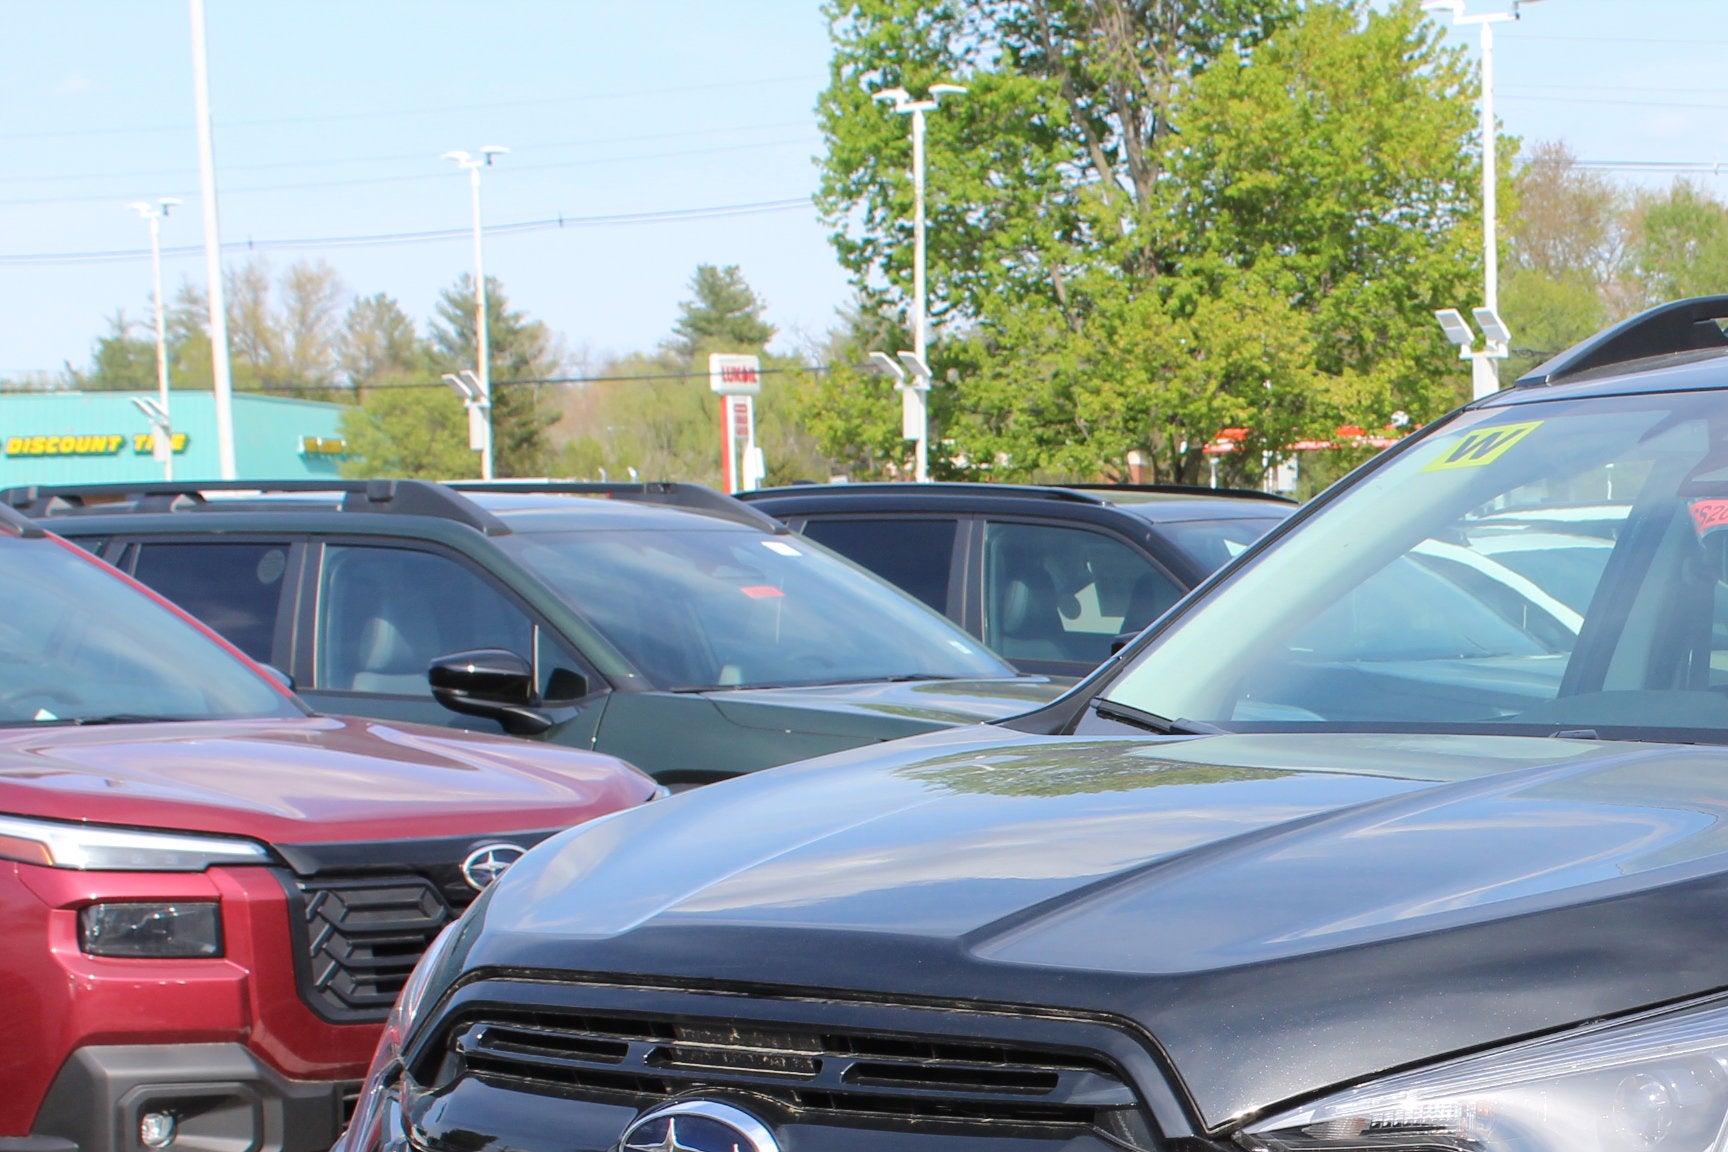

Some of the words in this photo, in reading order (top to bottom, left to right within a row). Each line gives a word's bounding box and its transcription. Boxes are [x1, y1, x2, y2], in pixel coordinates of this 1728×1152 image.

[6, 436, 123, 455] DISCOUNT
[134, 434, 188, 453] TIE
[1445, 428, 1528, 463] W
